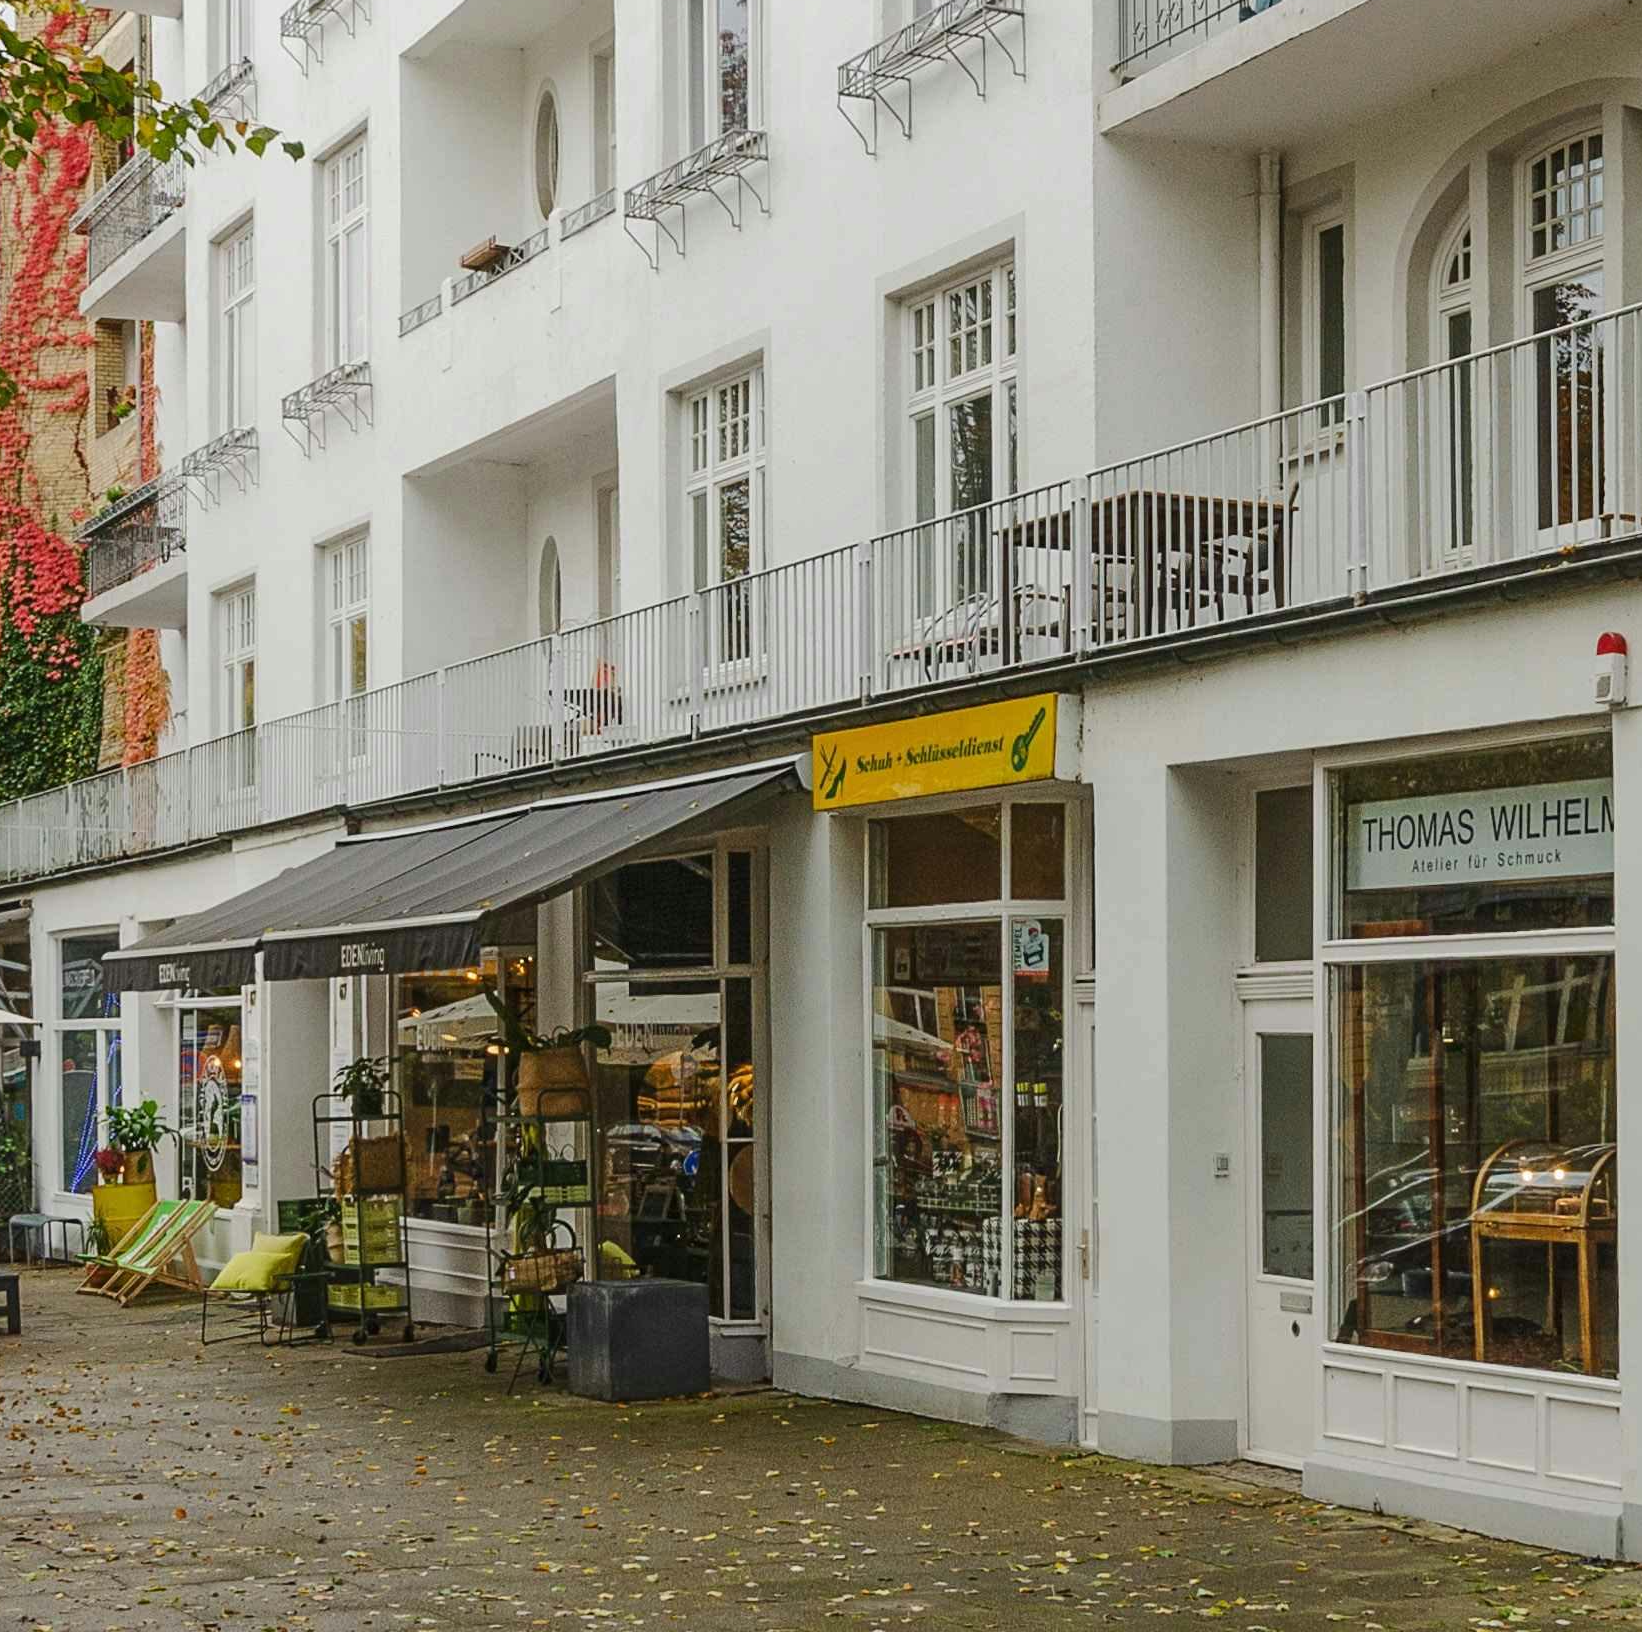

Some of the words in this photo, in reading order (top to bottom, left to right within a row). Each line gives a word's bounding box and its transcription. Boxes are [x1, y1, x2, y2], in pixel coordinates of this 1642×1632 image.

[856, 751, 893, 775] Schuh
[905, 735, 1005, 767] Schlüsseldienst
[1362, 808, 1475, 853] THOMAS
[1412, 859, 1458, 874] Atelier
[1469, 854, 1488, 869] für
[1497, 848, 1562, 867] Schmuck
